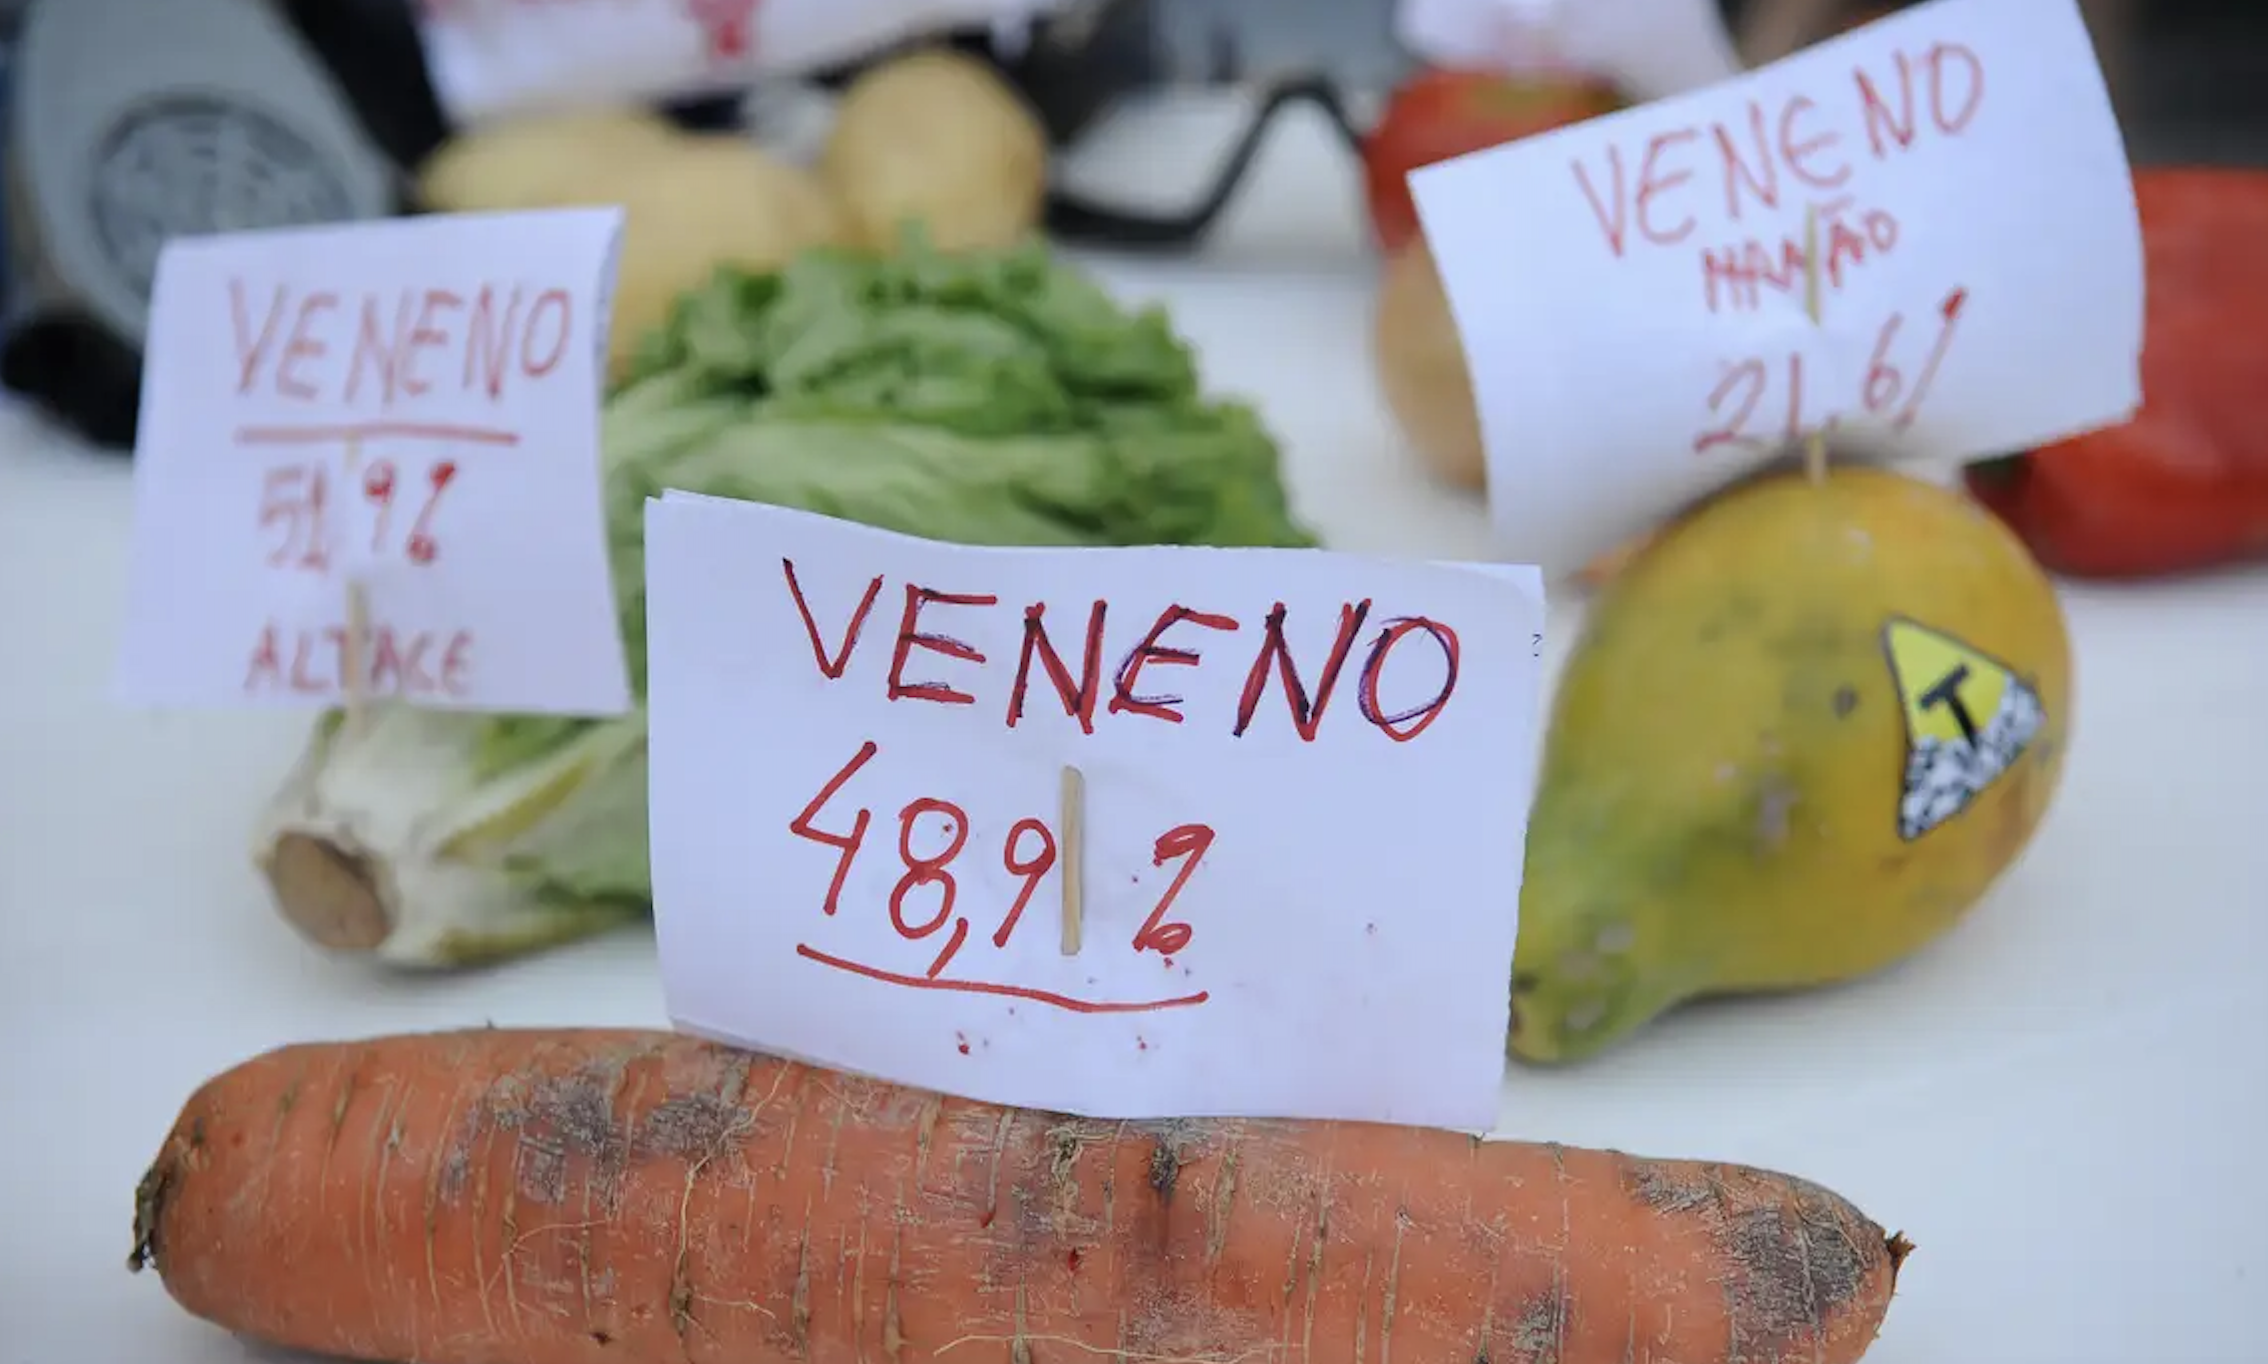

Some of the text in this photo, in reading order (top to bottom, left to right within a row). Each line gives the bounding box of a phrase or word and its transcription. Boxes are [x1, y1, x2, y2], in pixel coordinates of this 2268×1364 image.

[1570, 42, 1984, 258] VENENO
[230, 279, 572, 407] VENENO
[782, 556, 1460, 742] VENENO
